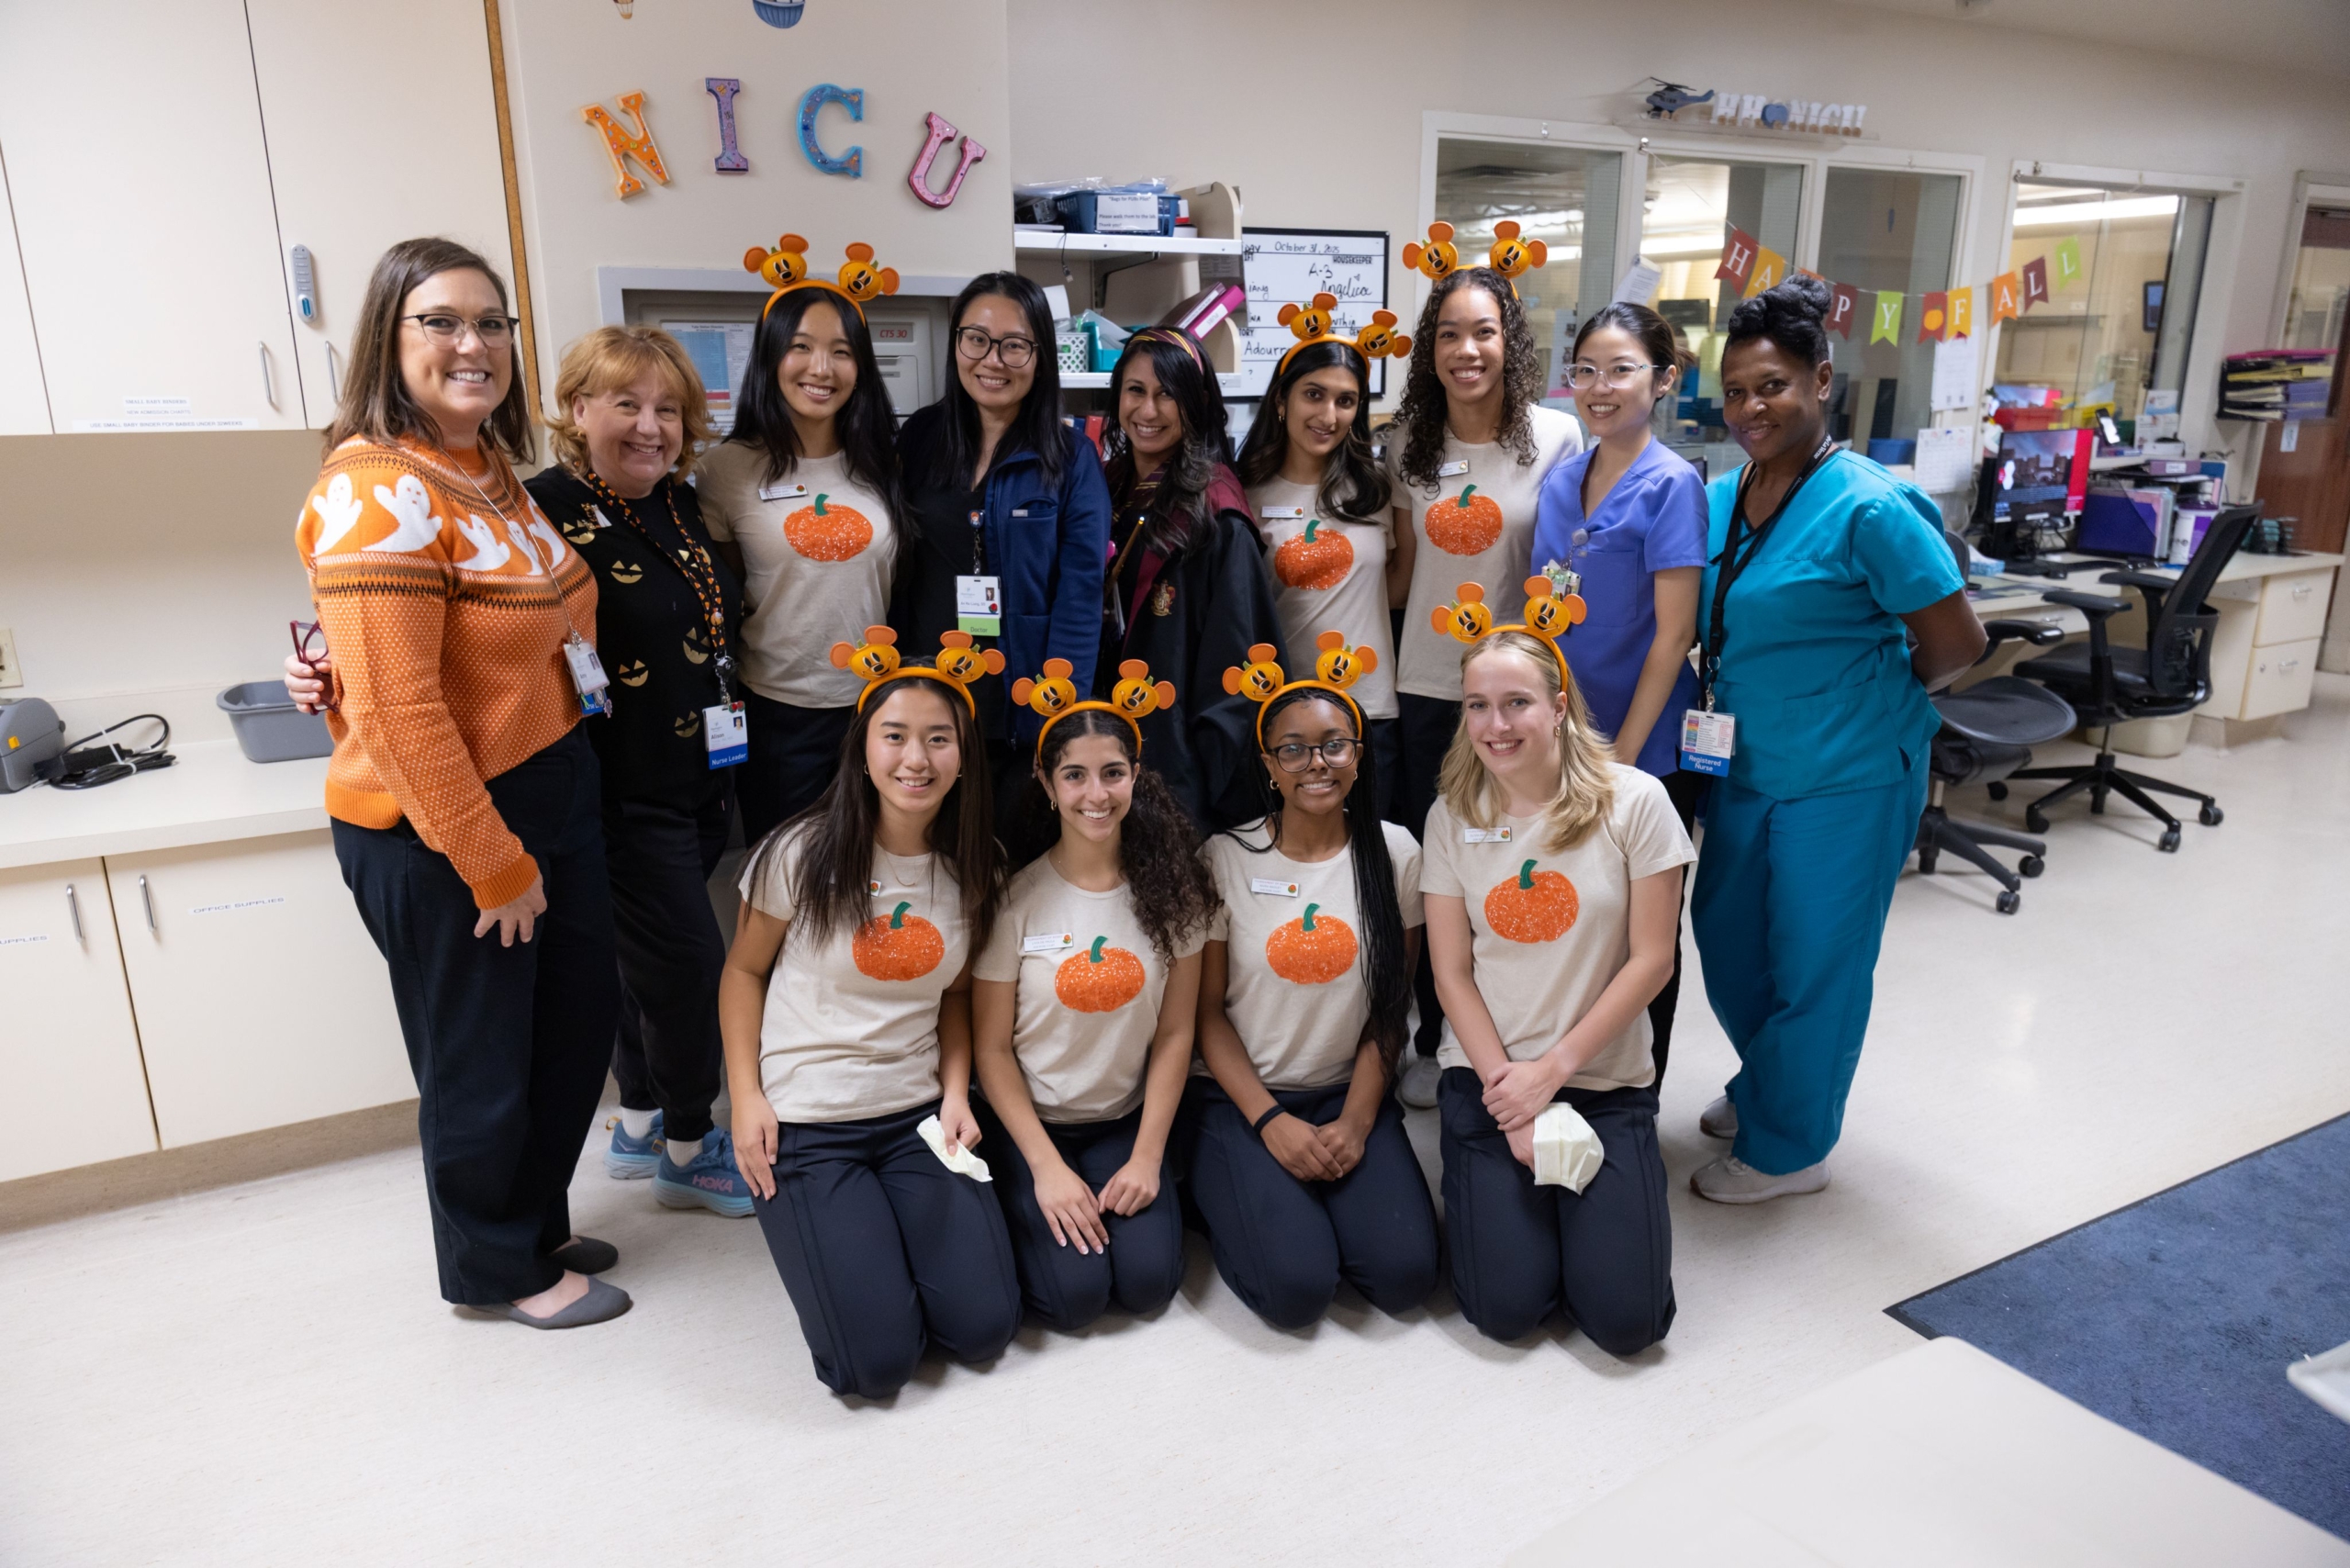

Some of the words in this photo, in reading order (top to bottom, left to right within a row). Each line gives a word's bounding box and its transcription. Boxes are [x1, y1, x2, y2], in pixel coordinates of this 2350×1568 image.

[580, 77, 987, 209] NICU
[1275, 241, 1306, 252] October
[1333, 256, 1372, 264] HOUSEKEEPER
[1308, 263, 1333, 279] A-3
[1725, 241, 1898, 330] HAPY
[1953, 252, 2076, 326] FALL
[879, 329, 895, 339] CTS
[896, 329, 908, 339] 30
[711, 757, 728, 766] Nurse
[729, 753, 746, 761] Leader
[1689, 755, 1722, 767] Registered
[1695, 763, 1714, 772] Nurse
[193, 904, 231, 913] OFFICE
[234, 897, 285, 908] SUPPLIES
[692, 1174, 733, 1193] HOKA
